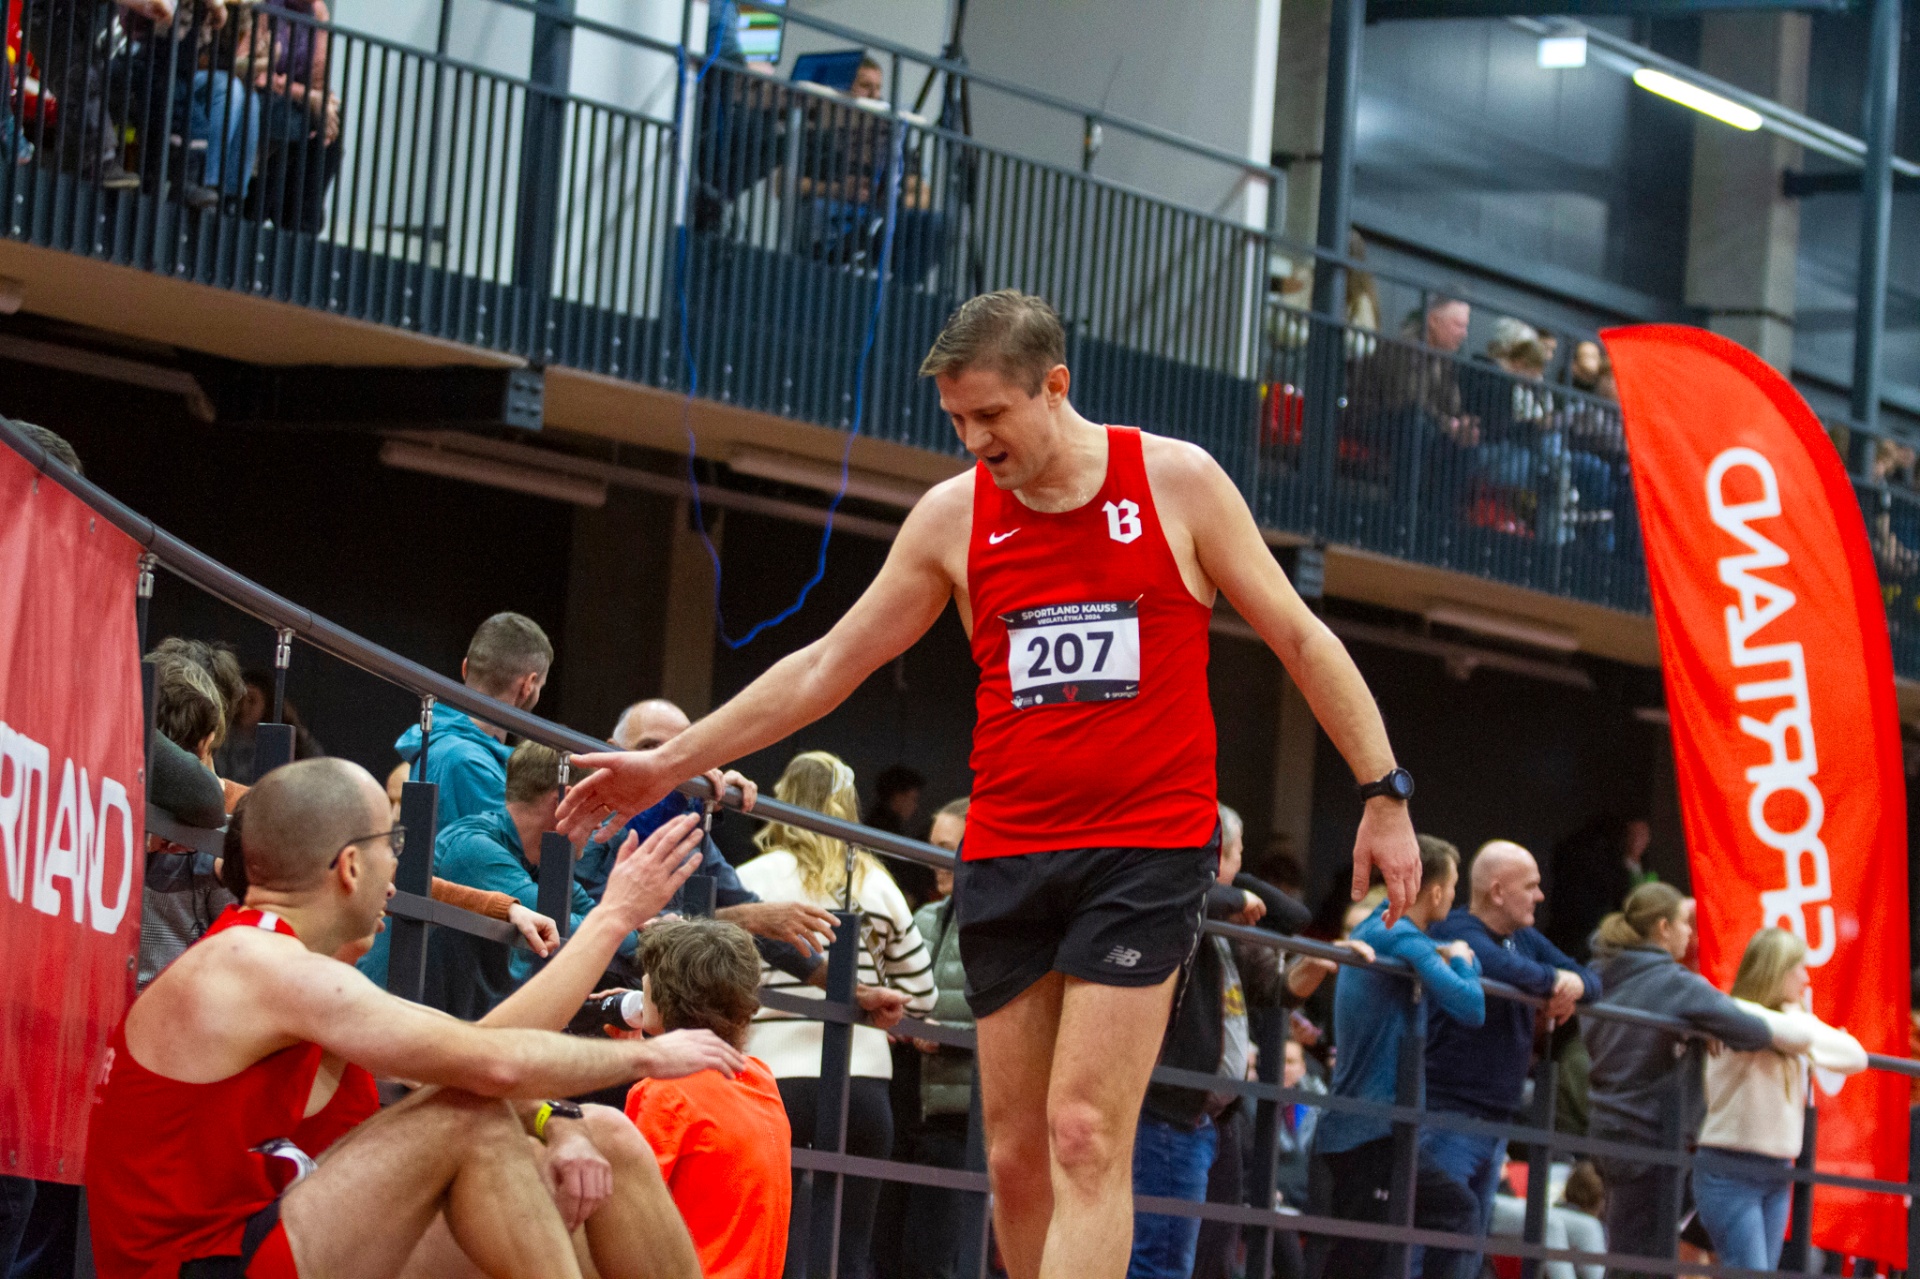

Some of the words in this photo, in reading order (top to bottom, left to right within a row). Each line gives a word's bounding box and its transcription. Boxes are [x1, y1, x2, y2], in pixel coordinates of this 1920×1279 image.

[1021, 605, 1080, 621] SPORTLAND
[1082, 603, 1118, 614] KAUSS
[1084, 613, 1101, 621] 2024
[1027, 631, 1114, 678] 207
